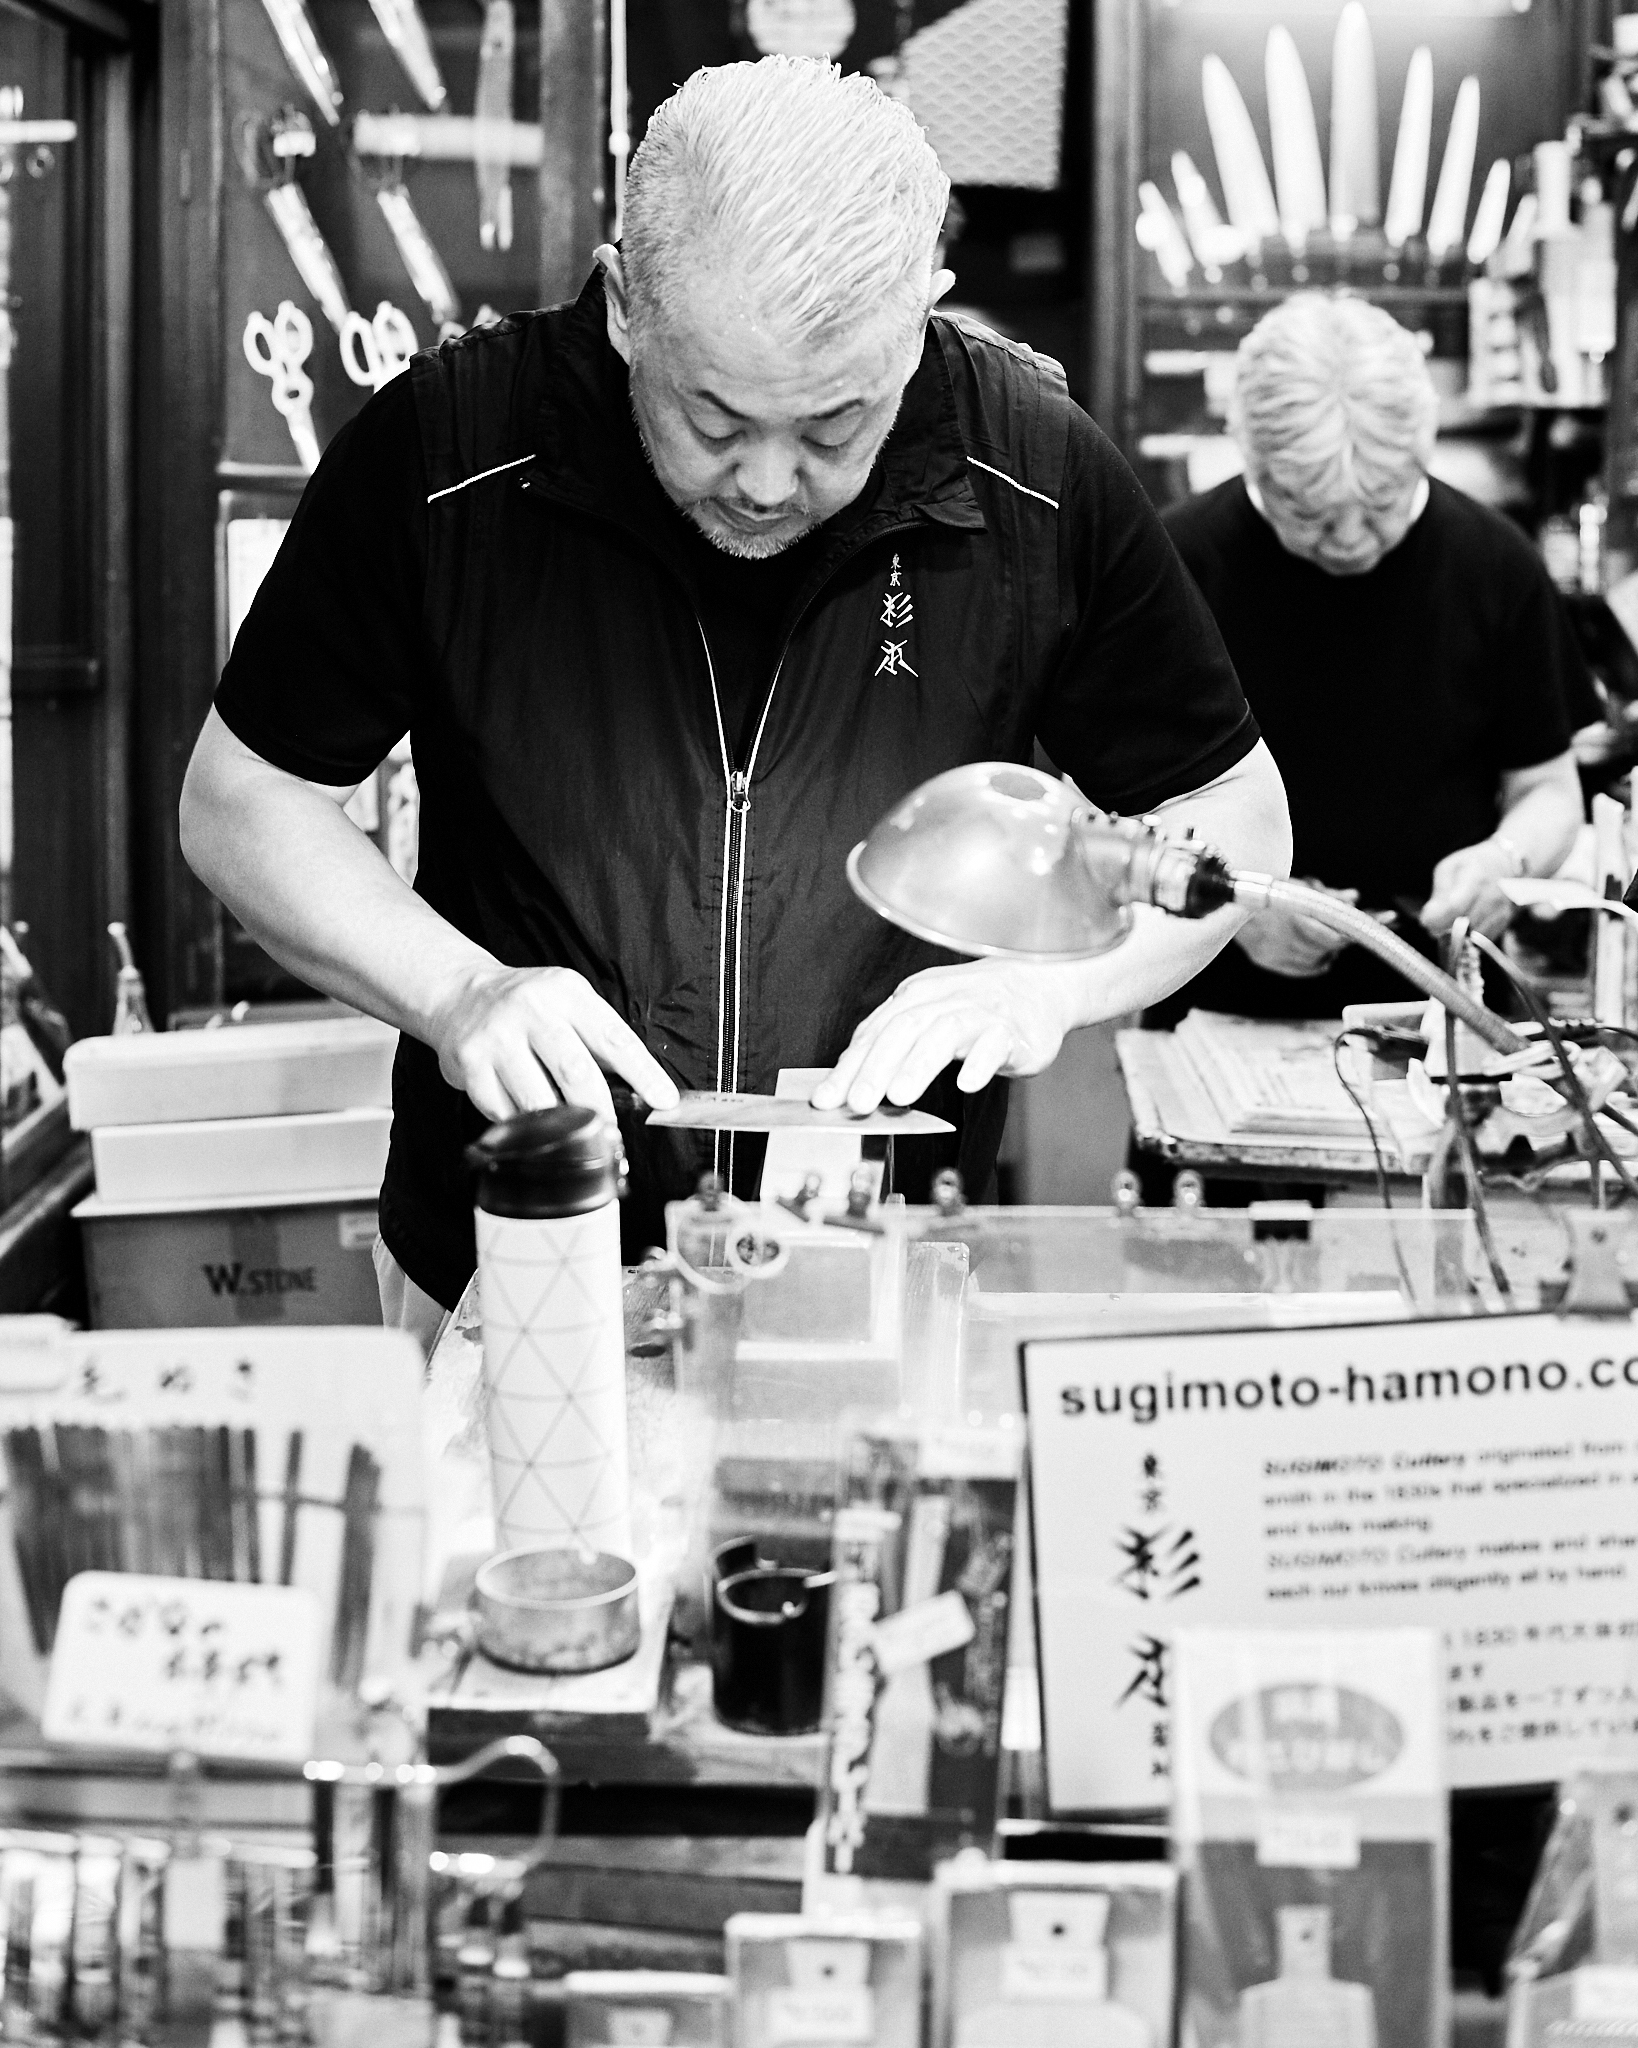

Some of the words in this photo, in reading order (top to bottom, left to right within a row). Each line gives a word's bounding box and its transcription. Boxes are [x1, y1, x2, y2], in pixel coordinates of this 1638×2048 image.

[1582, 1440, 1623, 1455] from
[1345, 1487, 1375, 1504] the
[1449, 1480, 1484, 1498] that
[1264, 1523, 1299, 1538] and
[1477, 1540, 1541, 1558] makes
[1551, 1535, 1587, 1553] and
